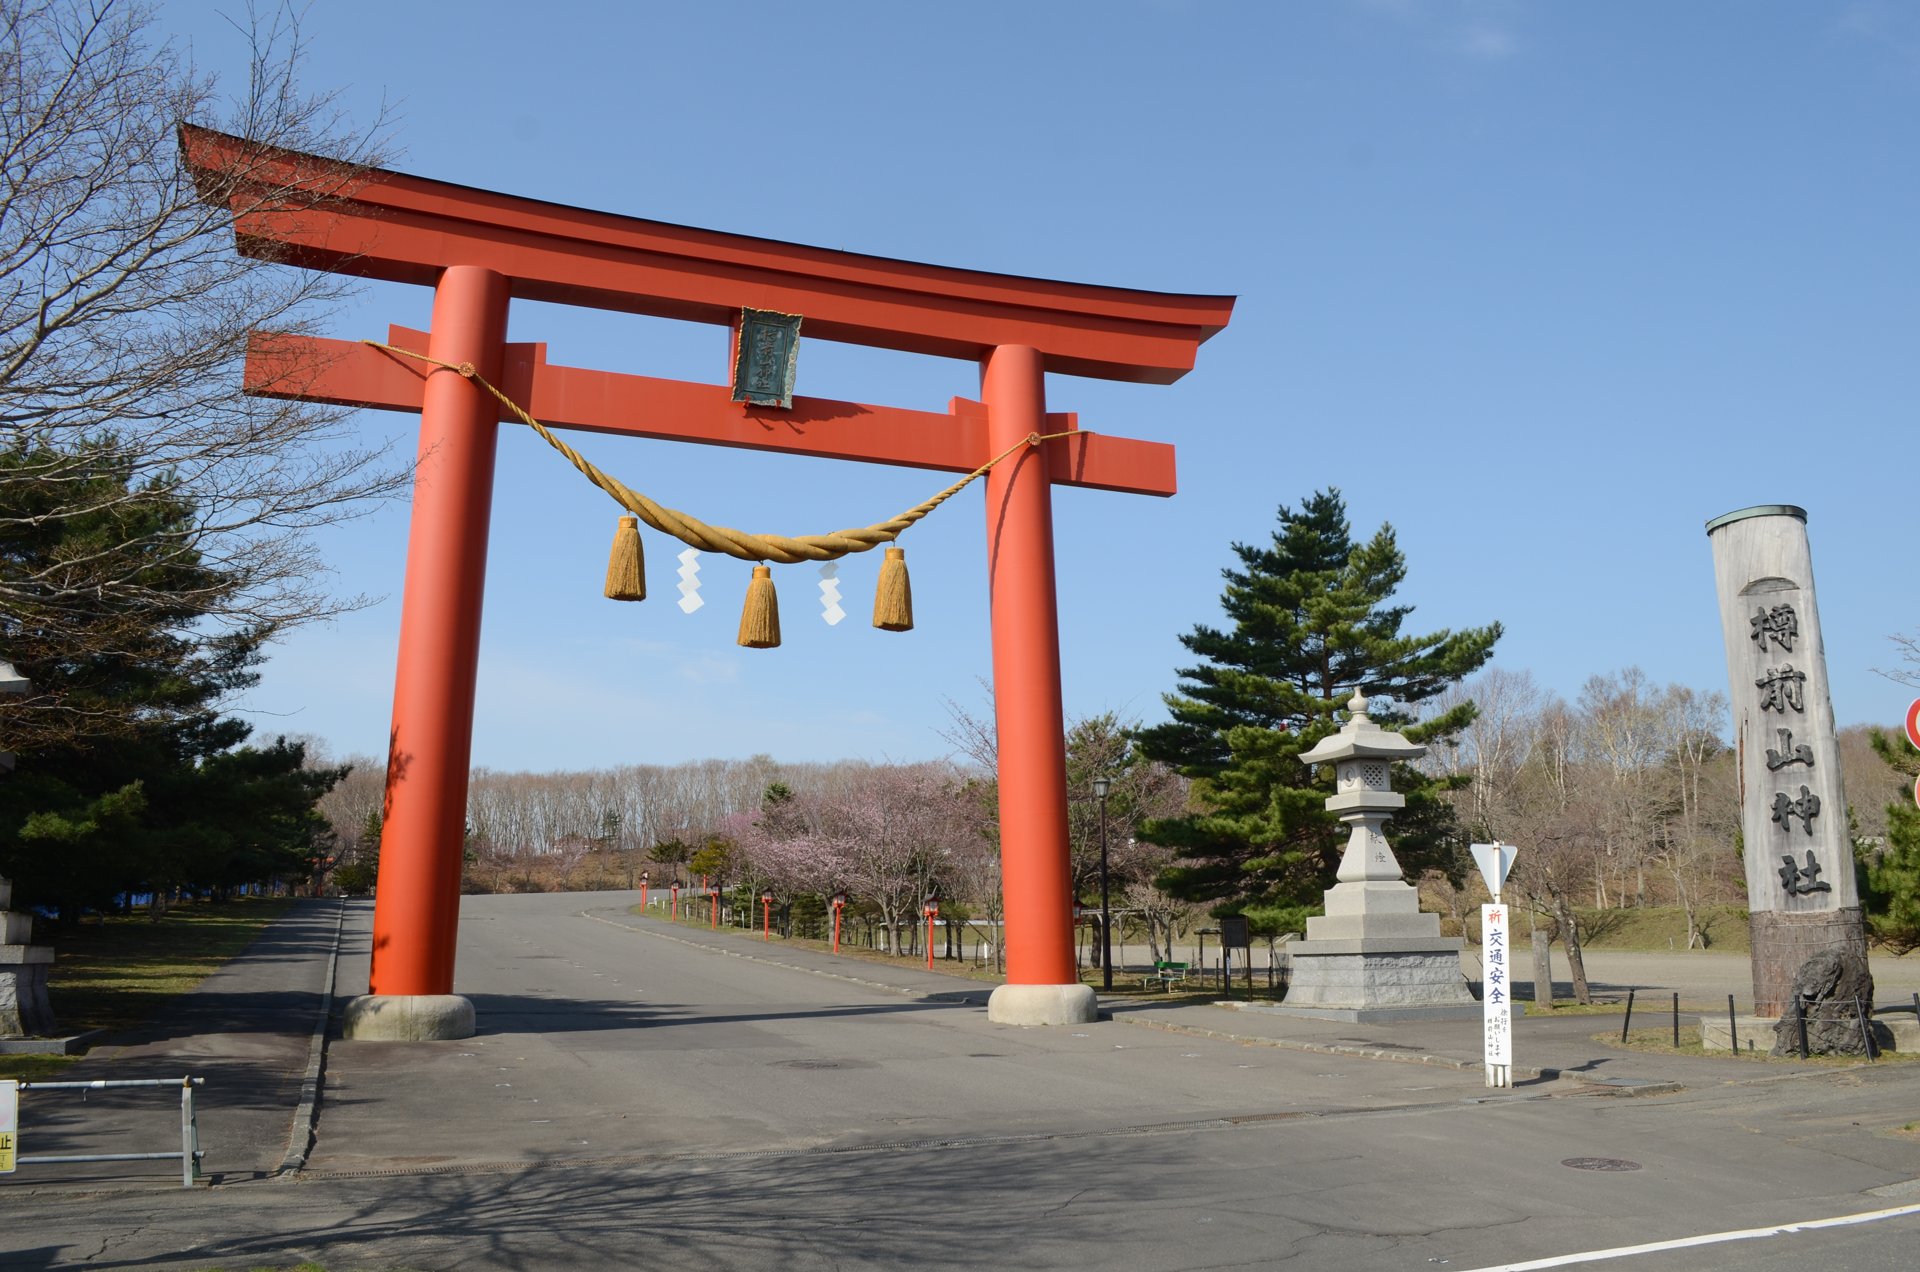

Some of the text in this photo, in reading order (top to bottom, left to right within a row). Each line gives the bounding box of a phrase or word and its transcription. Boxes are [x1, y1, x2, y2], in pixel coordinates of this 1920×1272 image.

[1750, 602, 1832, 898] 樽前山神社
